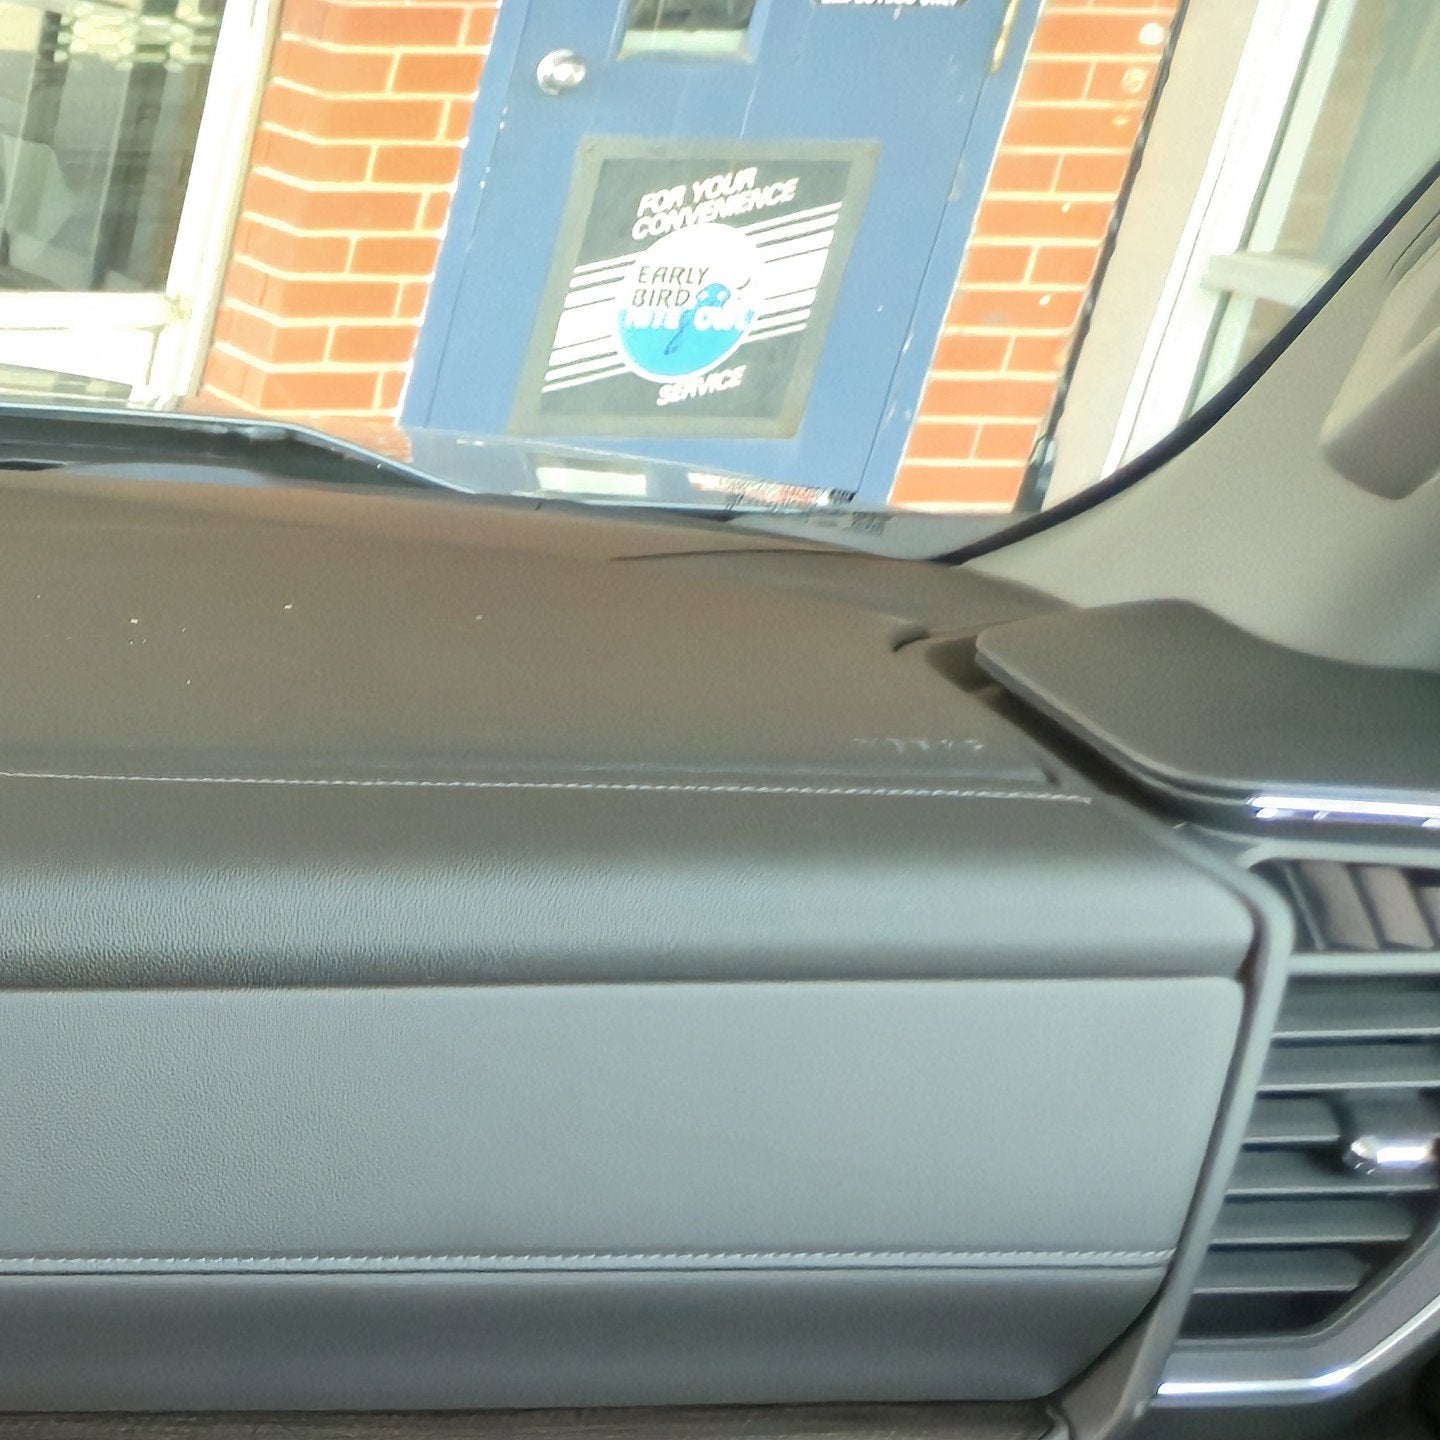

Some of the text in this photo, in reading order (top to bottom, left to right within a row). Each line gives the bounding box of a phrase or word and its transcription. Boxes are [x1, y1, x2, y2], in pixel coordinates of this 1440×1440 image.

[632, 178, 799, 240] CONVENIENCE
[637, 167, 758, 217] FOR YOUR
[638, 266, 709, 286] EARLY
[632, 289, 690, 307] BIRD
[657, 365, 746, 405] SERVICE
